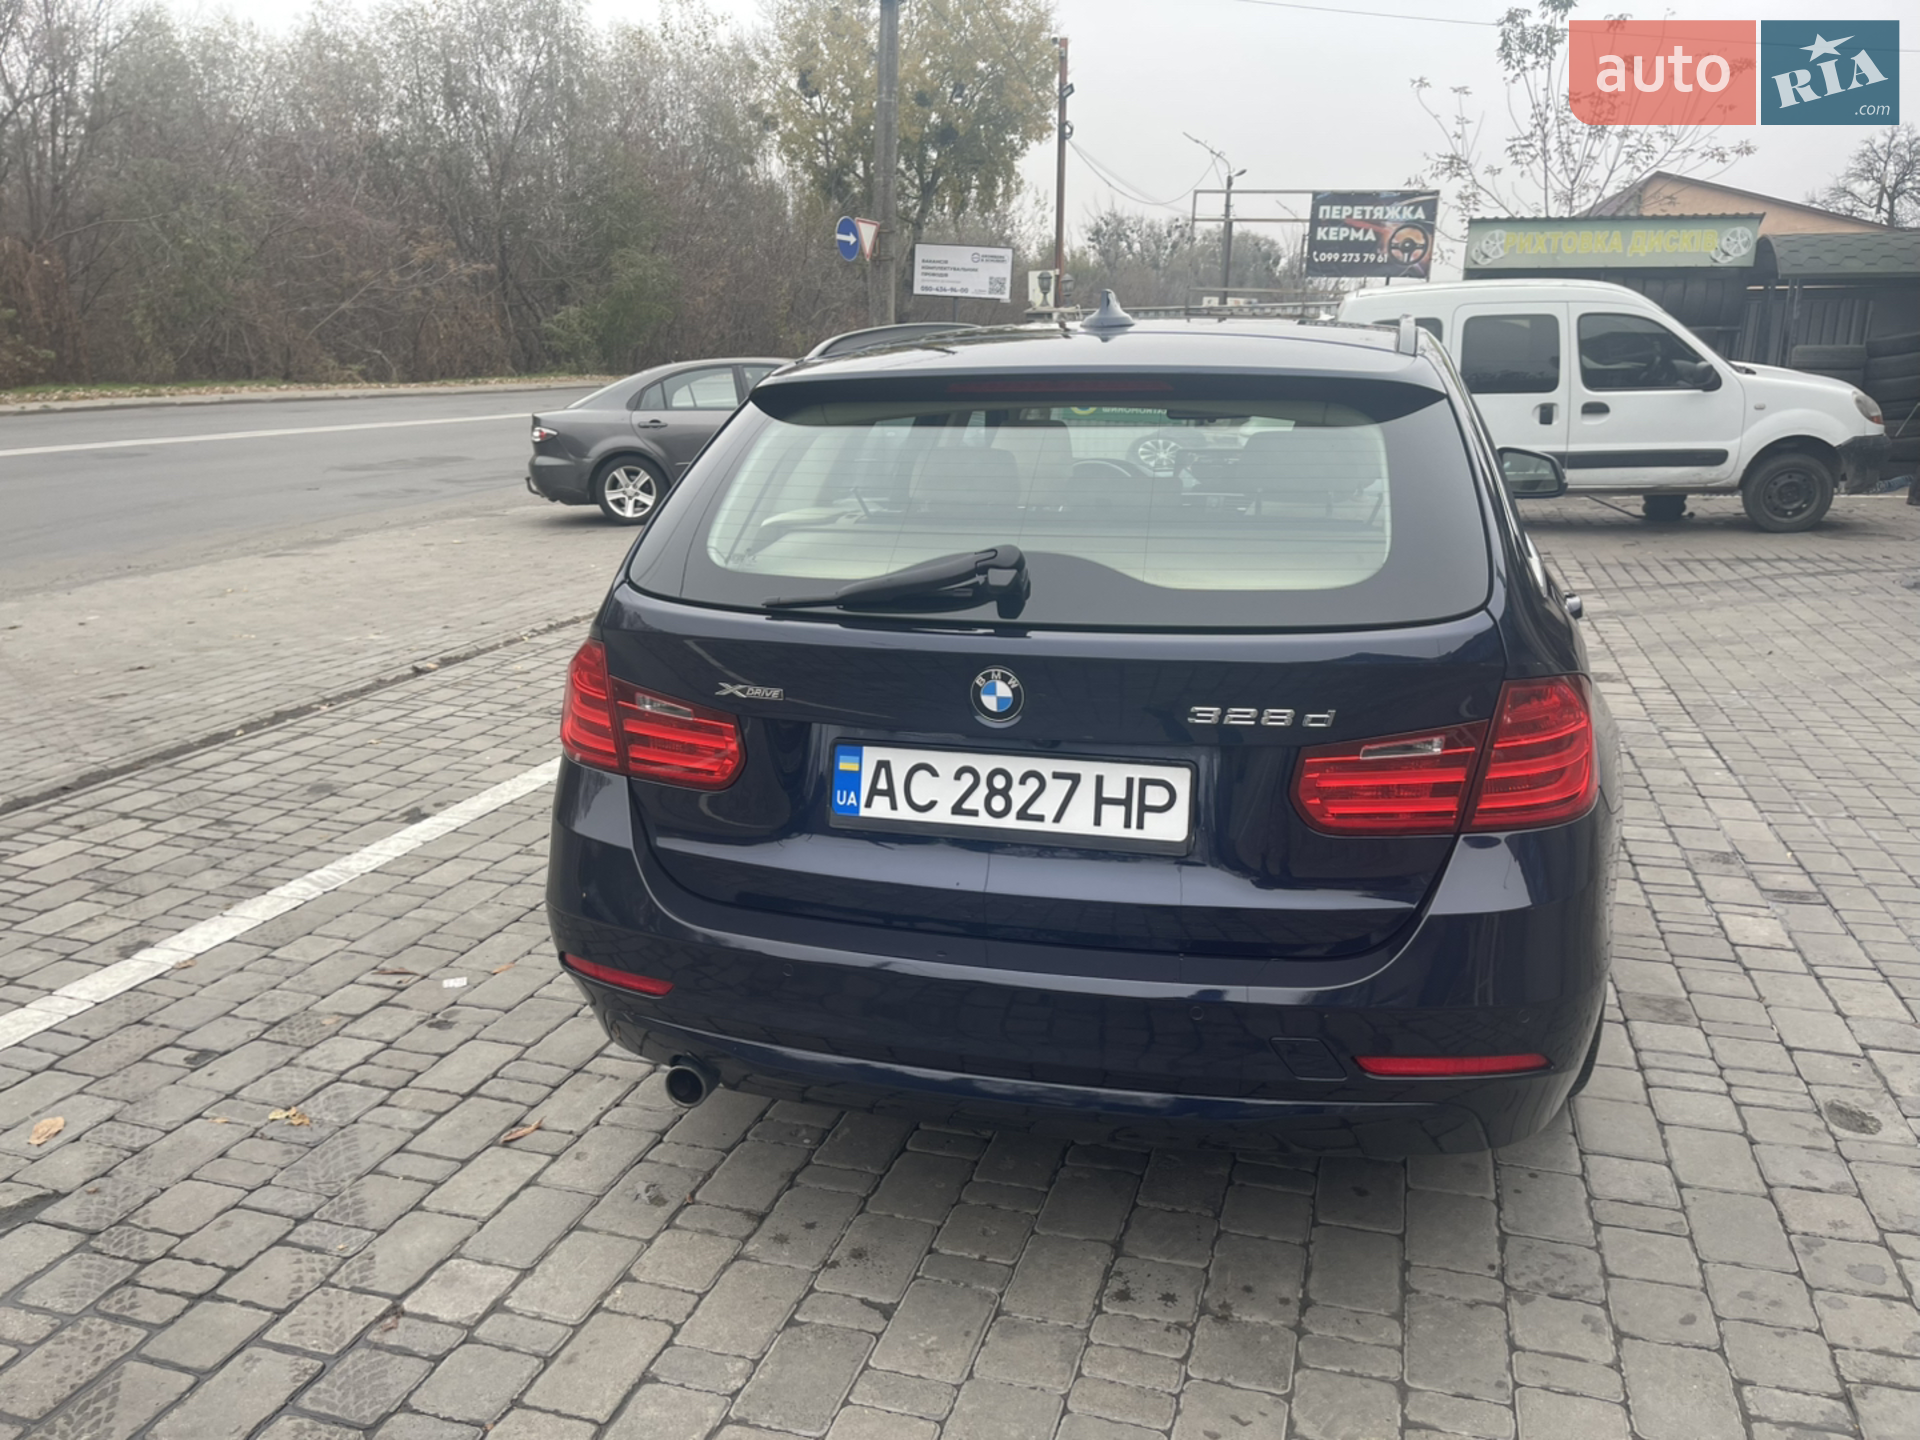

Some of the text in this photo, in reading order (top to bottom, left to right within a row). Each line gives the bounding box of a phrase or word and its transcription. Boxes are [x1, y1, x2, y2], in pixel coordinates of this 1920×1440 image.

[1318, 205, 1426, 220] ПЕРЕТЯЖКА
[1316, 227, 1376, 242] КЕРМА
[1503, 229, 1719, 257] РИХТОВКА ДИСКІВ
[1319, 253, 1388, 263] 099 273 79 61
[975, 670, 1019, 689] BMW
[836, 789, 858, 807] UA
[864, 759, 1177, 830] AC 2827 HP
